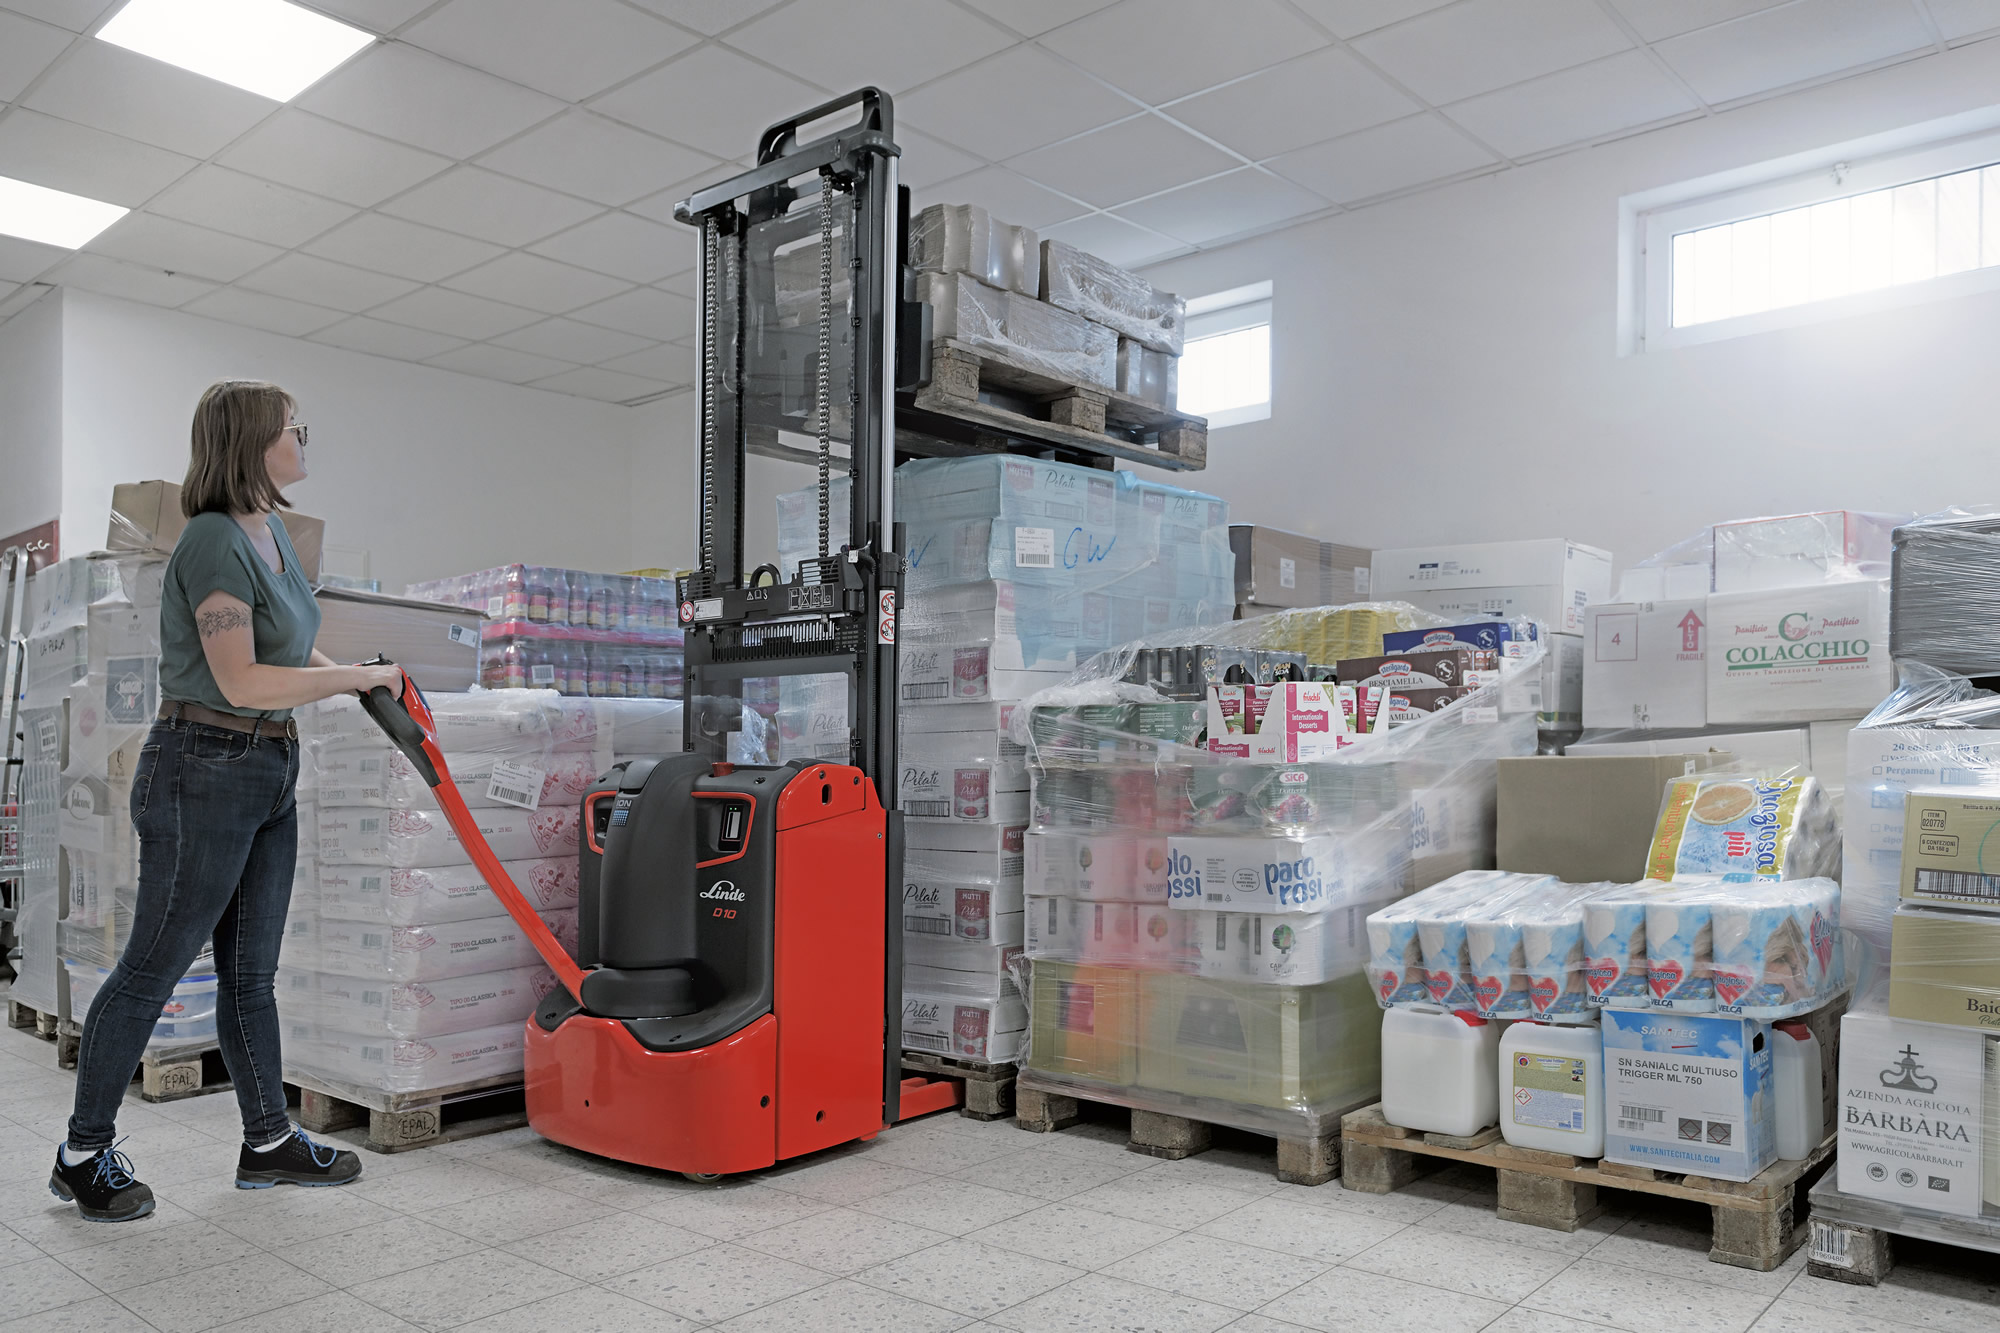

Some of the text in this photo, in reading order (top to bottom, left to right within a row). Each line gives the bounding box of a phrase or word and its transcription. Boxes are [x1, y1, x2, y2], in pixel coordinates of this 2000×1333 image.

[955, 370, 975, 389] EPAL
[1045, 469, 1075, 489] Pelati
[1173, 496, 1199, 513] Pelati
[1822, 617, 1860, 628] Pastificio
[1735, 624, 1768, 635] Panificio
[1424, 632, 1453, 644] sterilgarda
[1611, 632, 1621, 646] 4
[1676, 653, 1704, 661] FRAGILE
[1725, 639, 1870, 664] COLACCHIO
[1380, 664, 1410, 675] sterilgarda
[1369, 677, 1424, 688] BESCIAMELLA
[1292, 713, 1323, 721] Internationale
[1886, 766, 1935, 776] Pergamena
[902, 768, 939, 789] Pelati
[616, 799, 632, 807] ION
[1922, 819, 1945, 828] 020778
[1723, 832, 1751, 857] più
[699, 880, 746, 902] Linde
[903, 884, 939, 904] Pelati
[471, 938, 497, 946] CLASSICA
[471, 992, 497, 1002] CLASSICA
[1588, 994, 1610, 1005] VELCA
[1651, 998, 1673, 1008] VELCA
[902, 999, 939, 1019] Pelati
[1718, 1005, 1743, 1015] VELCA
[1533, 1012, 1553, 1021] VELCA
[472, 1045, 498, 1056] CLASSICA
[1618, 1057, 1738, 1078] SN SANIALC MULTIUSO
[163, 1070, 193, 1092] EPAL
[1618, 1068, 1703, 1085] TRIGGER ML 750
[1846, 1089, 1971, 1116] AZIENDA AGRICOLA
[401, 1117, 431, 1135] EPAL
[1630, 1144, 1721, 1164] WWW.SANITECITALIA.COM
[1851, 1141, 1965, 1168] WWW.AGRICOLABARBARA.IT
